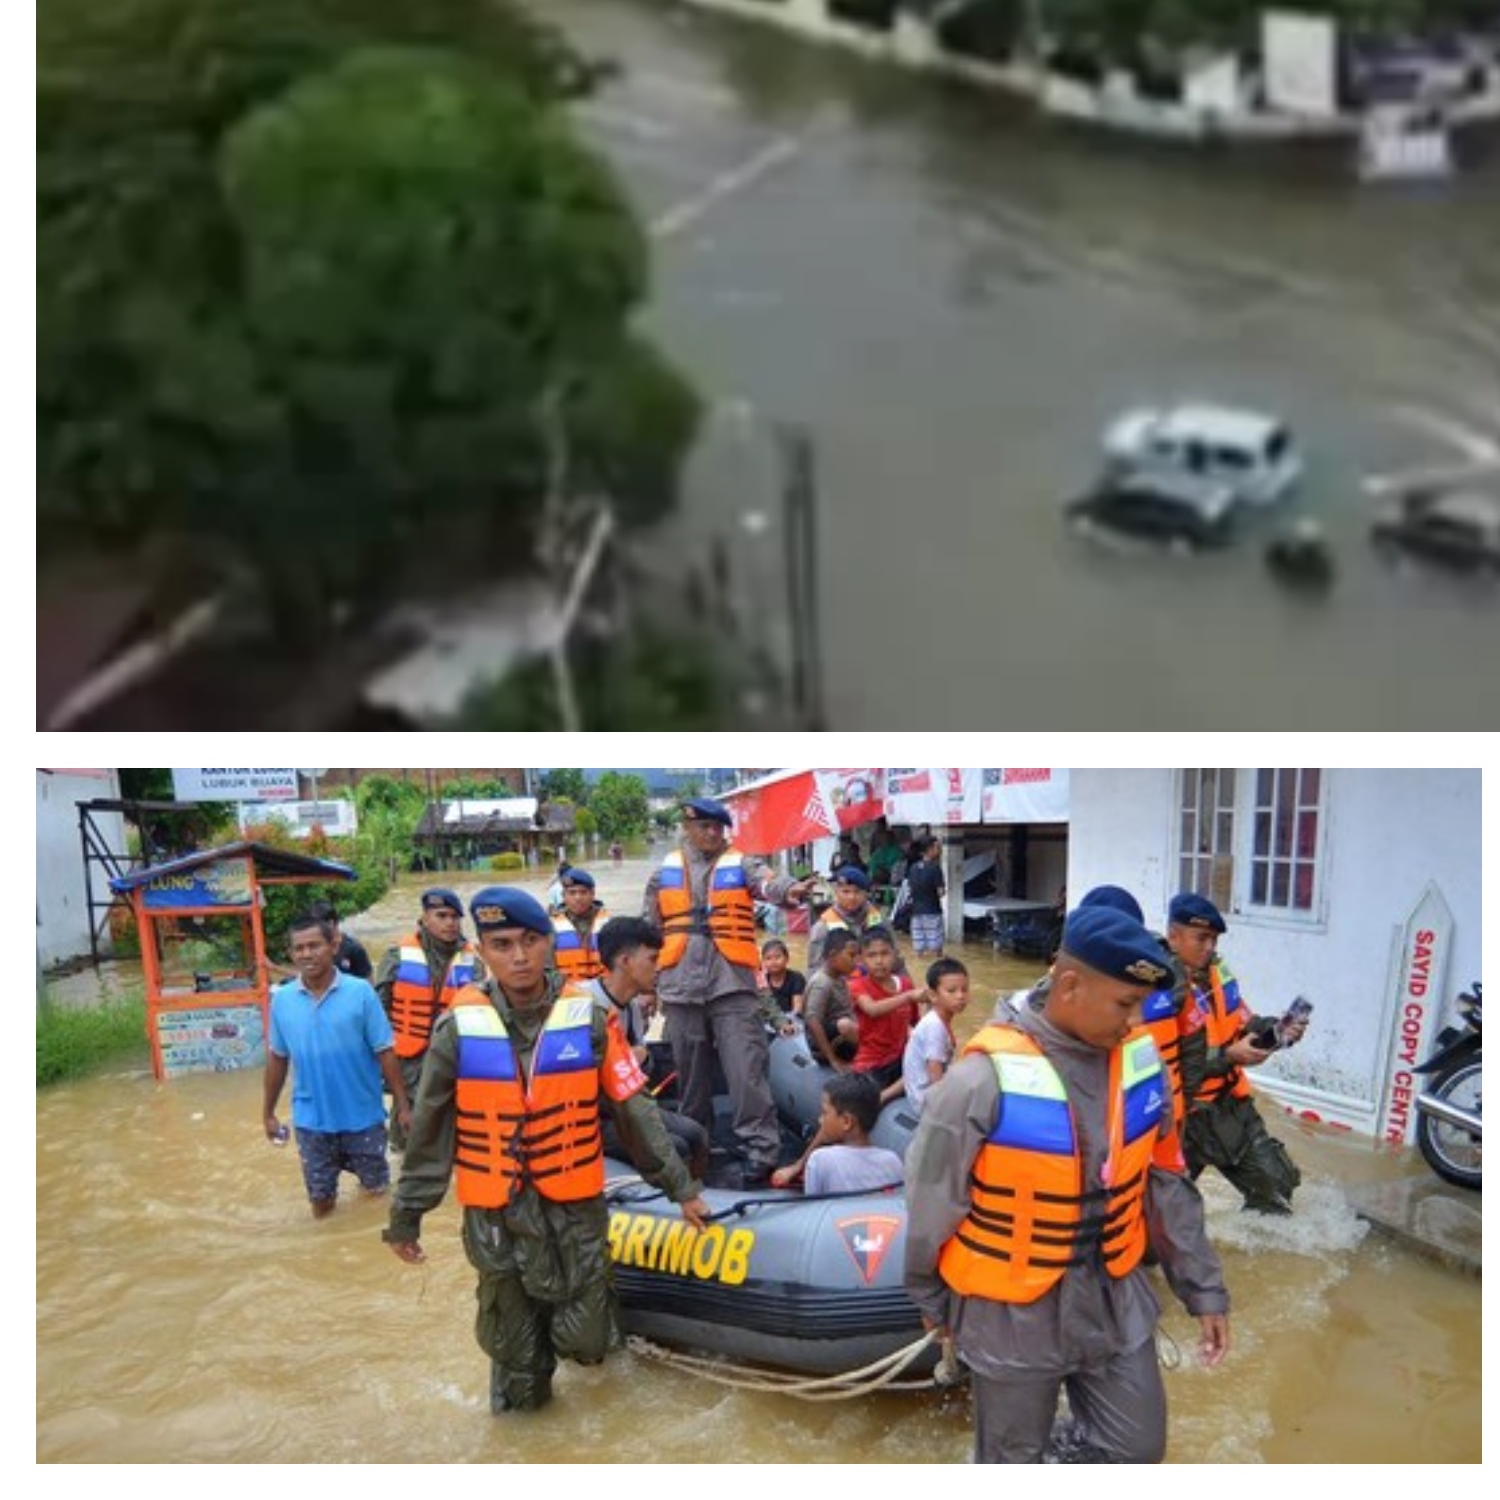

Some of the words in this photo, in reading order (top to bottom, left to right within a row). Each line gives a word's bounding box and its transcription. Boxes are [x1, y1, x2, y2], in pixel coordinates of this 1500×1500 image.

[1408, 930, 1435, 997] SAYID
[1399, 1005, 1424, 1066] COPY
[607, 1211, 755, 1285] BRIMOB
